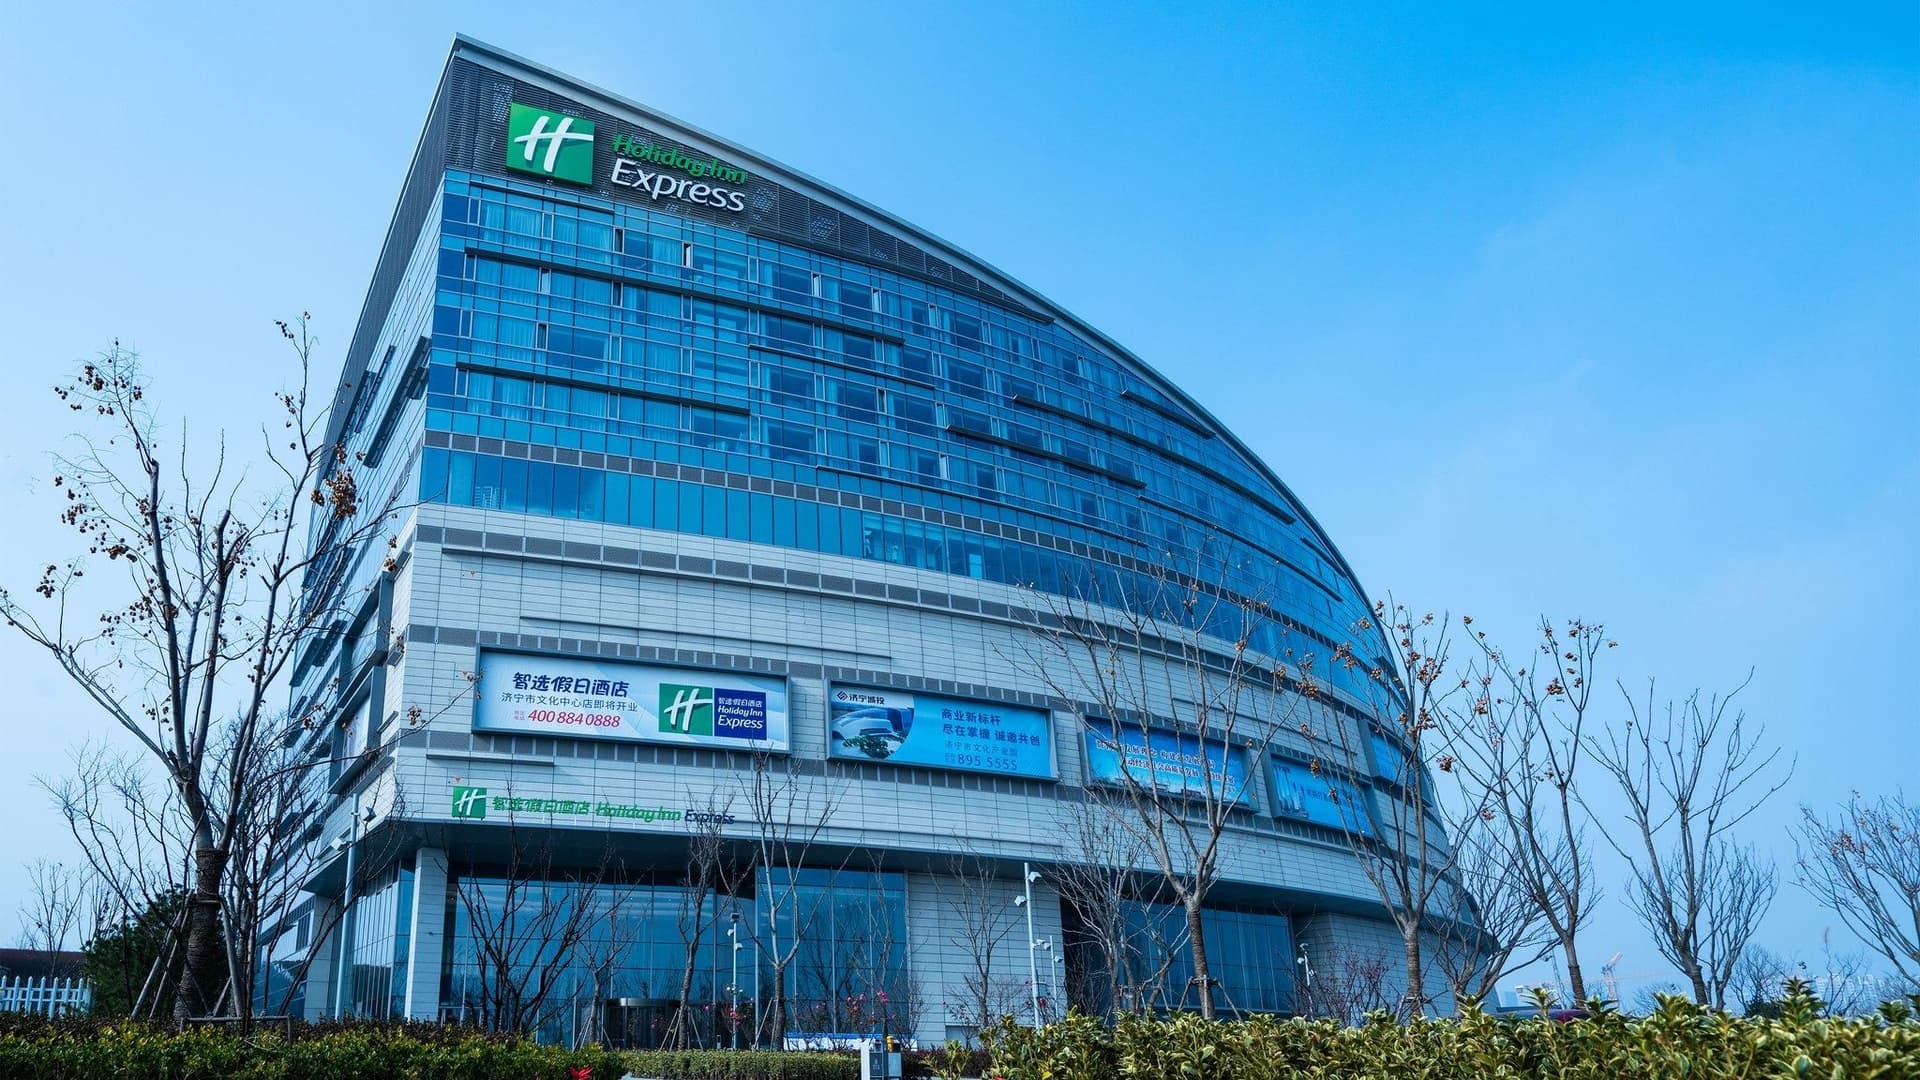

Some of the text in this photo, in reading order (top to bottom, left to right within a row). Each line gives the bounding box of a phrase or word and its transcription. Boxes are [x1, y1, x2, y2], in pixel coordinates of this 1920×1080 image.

[610, 158, 746, 212] Express
[512, 672, 629, 698] 智选假日酒店
[501, 691, 638, 712] 济宁市文化中心店即将开业
[528, 709, 556, 723] 400
[557, 710, 584, 725] 884
[585, 713, 621, 728] 0888
[718, 714, 763, 729] Express
[941, 707, 1000, 726] 商业新标杆
[958, 753, 981, 767] 895
[986, 756, 1018, 771] 5555
[684, 808, 735, 825] Express
